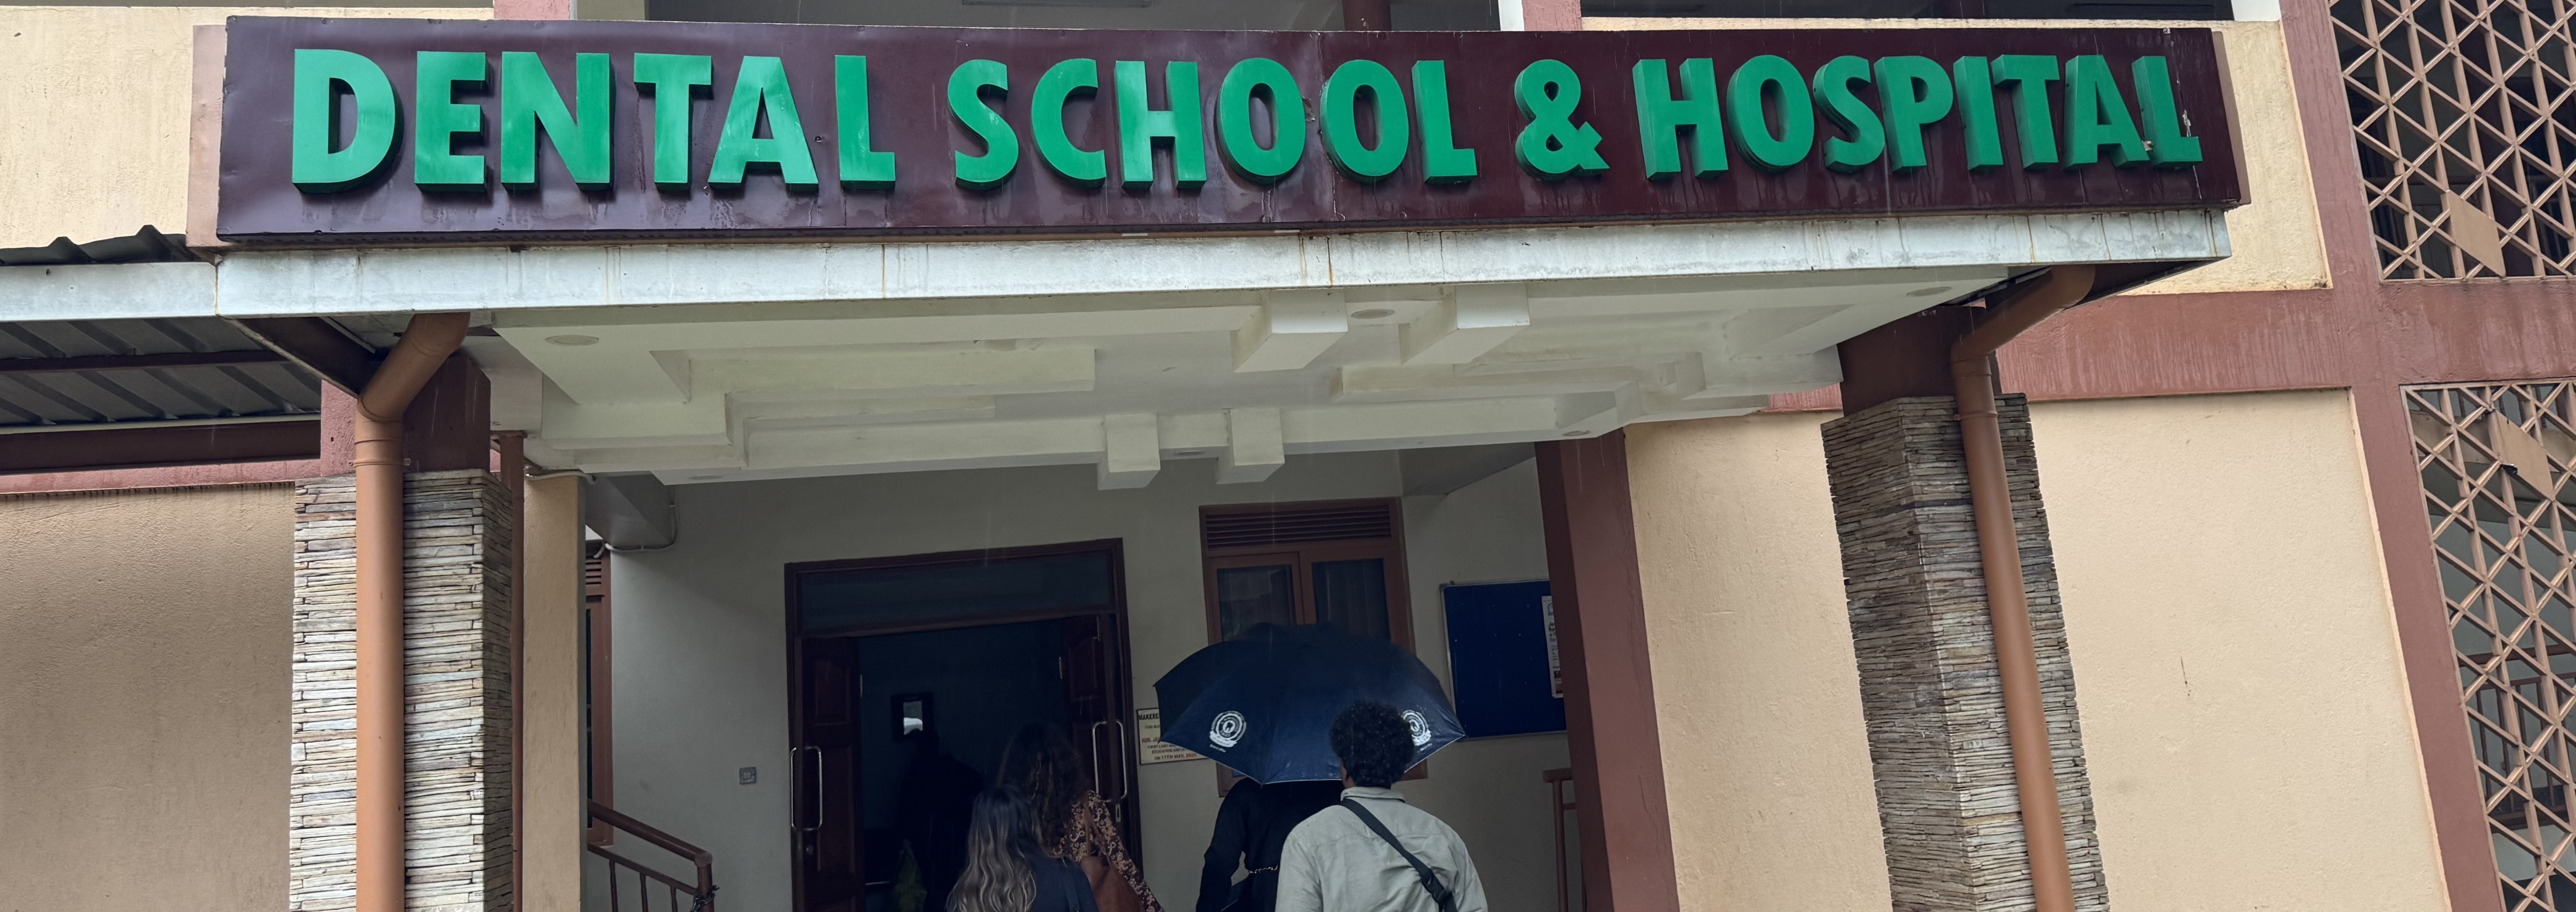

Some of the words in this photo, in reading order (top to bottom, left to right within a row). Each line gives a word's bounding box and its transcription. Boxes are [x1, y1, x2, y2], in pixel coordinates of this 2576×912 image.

[292, 49, 897, 190] DENTAL
[947, 58, 1478, 186] SCHOOL
[1514, 59, 1610, 177] &
[1632, 54, 2204, 179] HOSPITAL
